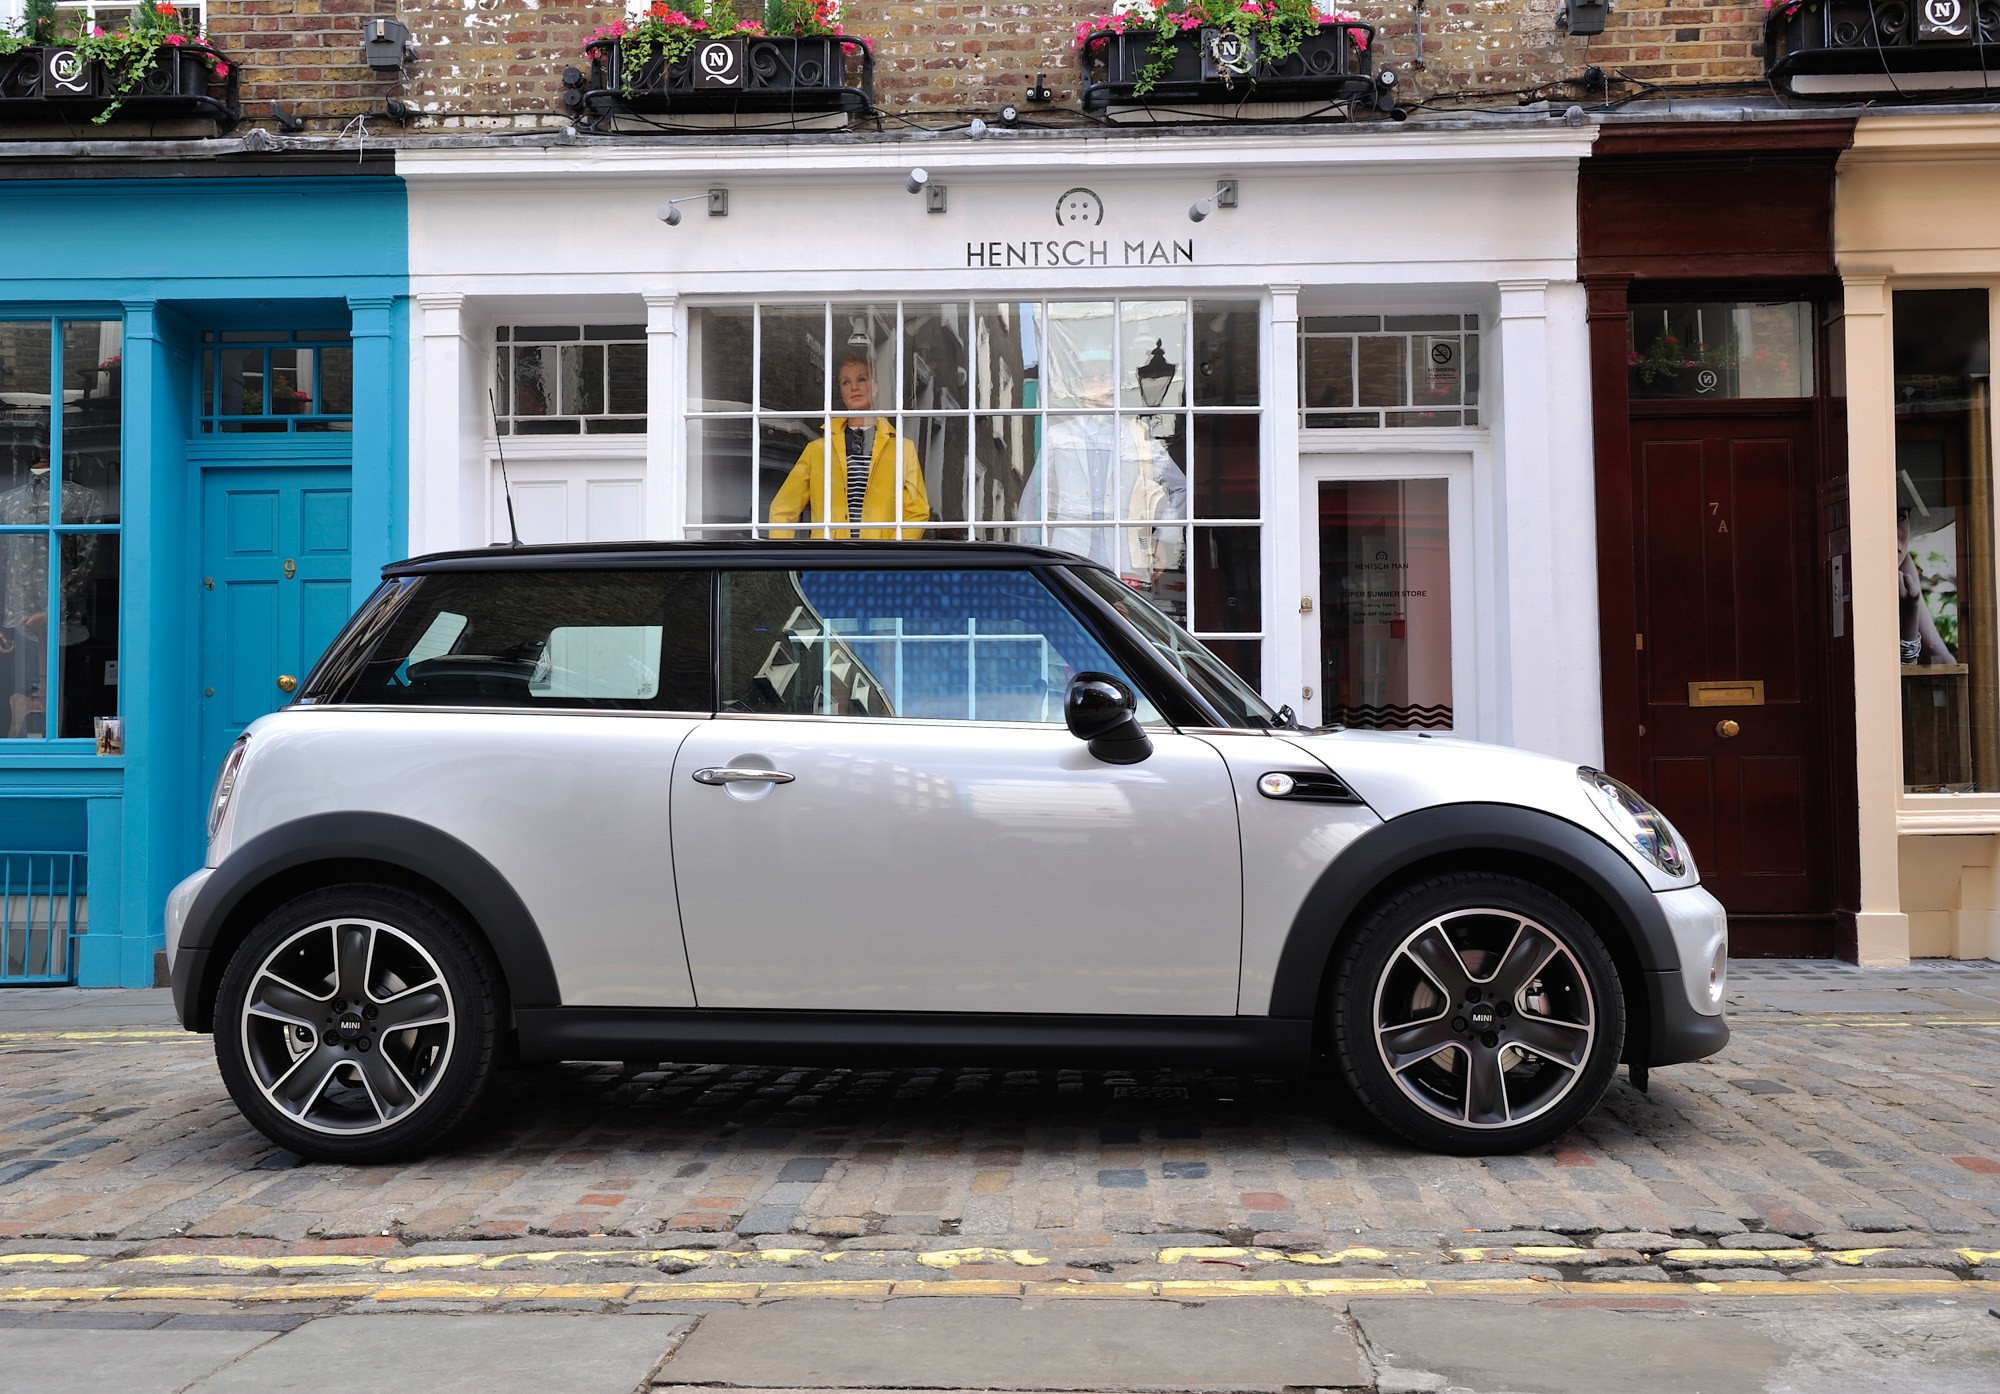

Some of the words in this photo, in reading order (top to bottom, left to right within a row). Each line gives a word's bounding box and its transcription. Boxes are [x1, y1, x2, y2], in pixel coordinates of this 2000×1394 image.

[967, 240, 1107, 267] HENTSCH
[1124, 239, 1193, 265] MAN
[1709, 502, 1719, 515] 7
[1718, 519, 1729, 532] A
[283, 558, 296, 579] 9
[1472, 1014, 1493, 1022] MINI
[340, 1021, 361, 1029] MINI
